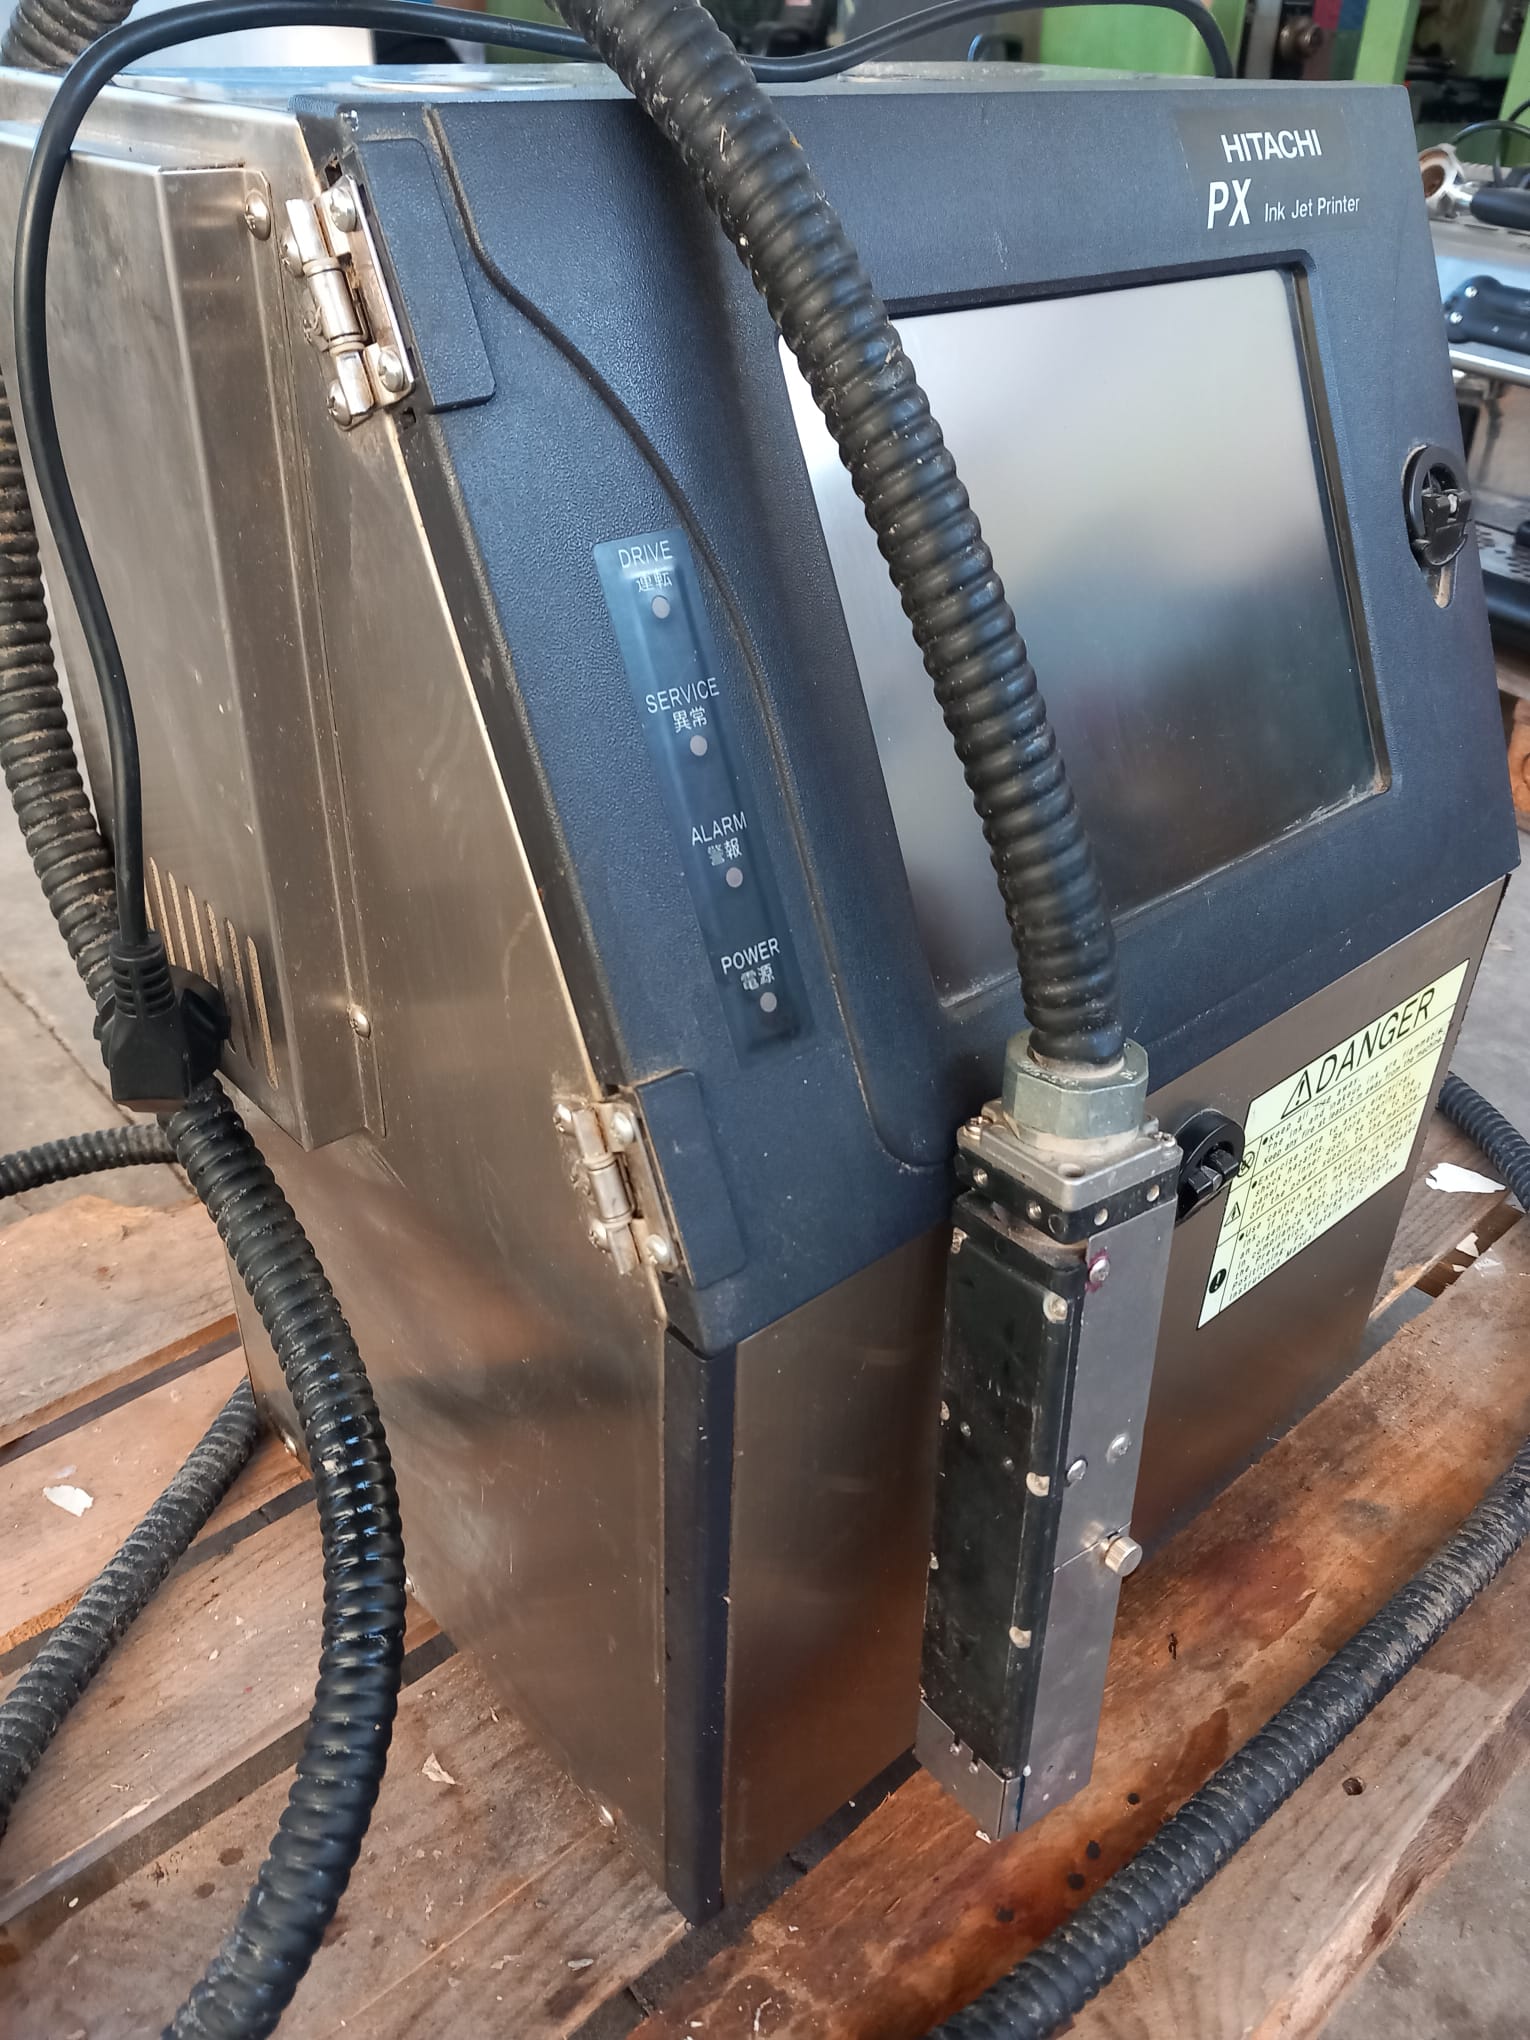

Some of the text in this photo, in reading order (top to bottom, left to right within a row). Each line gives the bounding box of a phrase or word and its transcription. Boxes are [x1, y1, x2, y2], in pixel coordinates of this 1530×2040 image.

[1220, 129, 1323, 163] HITACHI
[1207, 178, 1361, 229] PX Ink Jet Printer
[618, 541, 673, 569] DRIVE
[635, 569, 673, 593] 運転
[645, 677, 720, 714] SERVICE
[672, 706, 708, 734] 異常
[691, 811, 748, 847] ALARM
[707, 837, 743, 866] 警報
[720, 937, 781, 975] POWER
[740, 962, 775, 991] 電源
[1315, 987, 1436, 1094] DANGER
